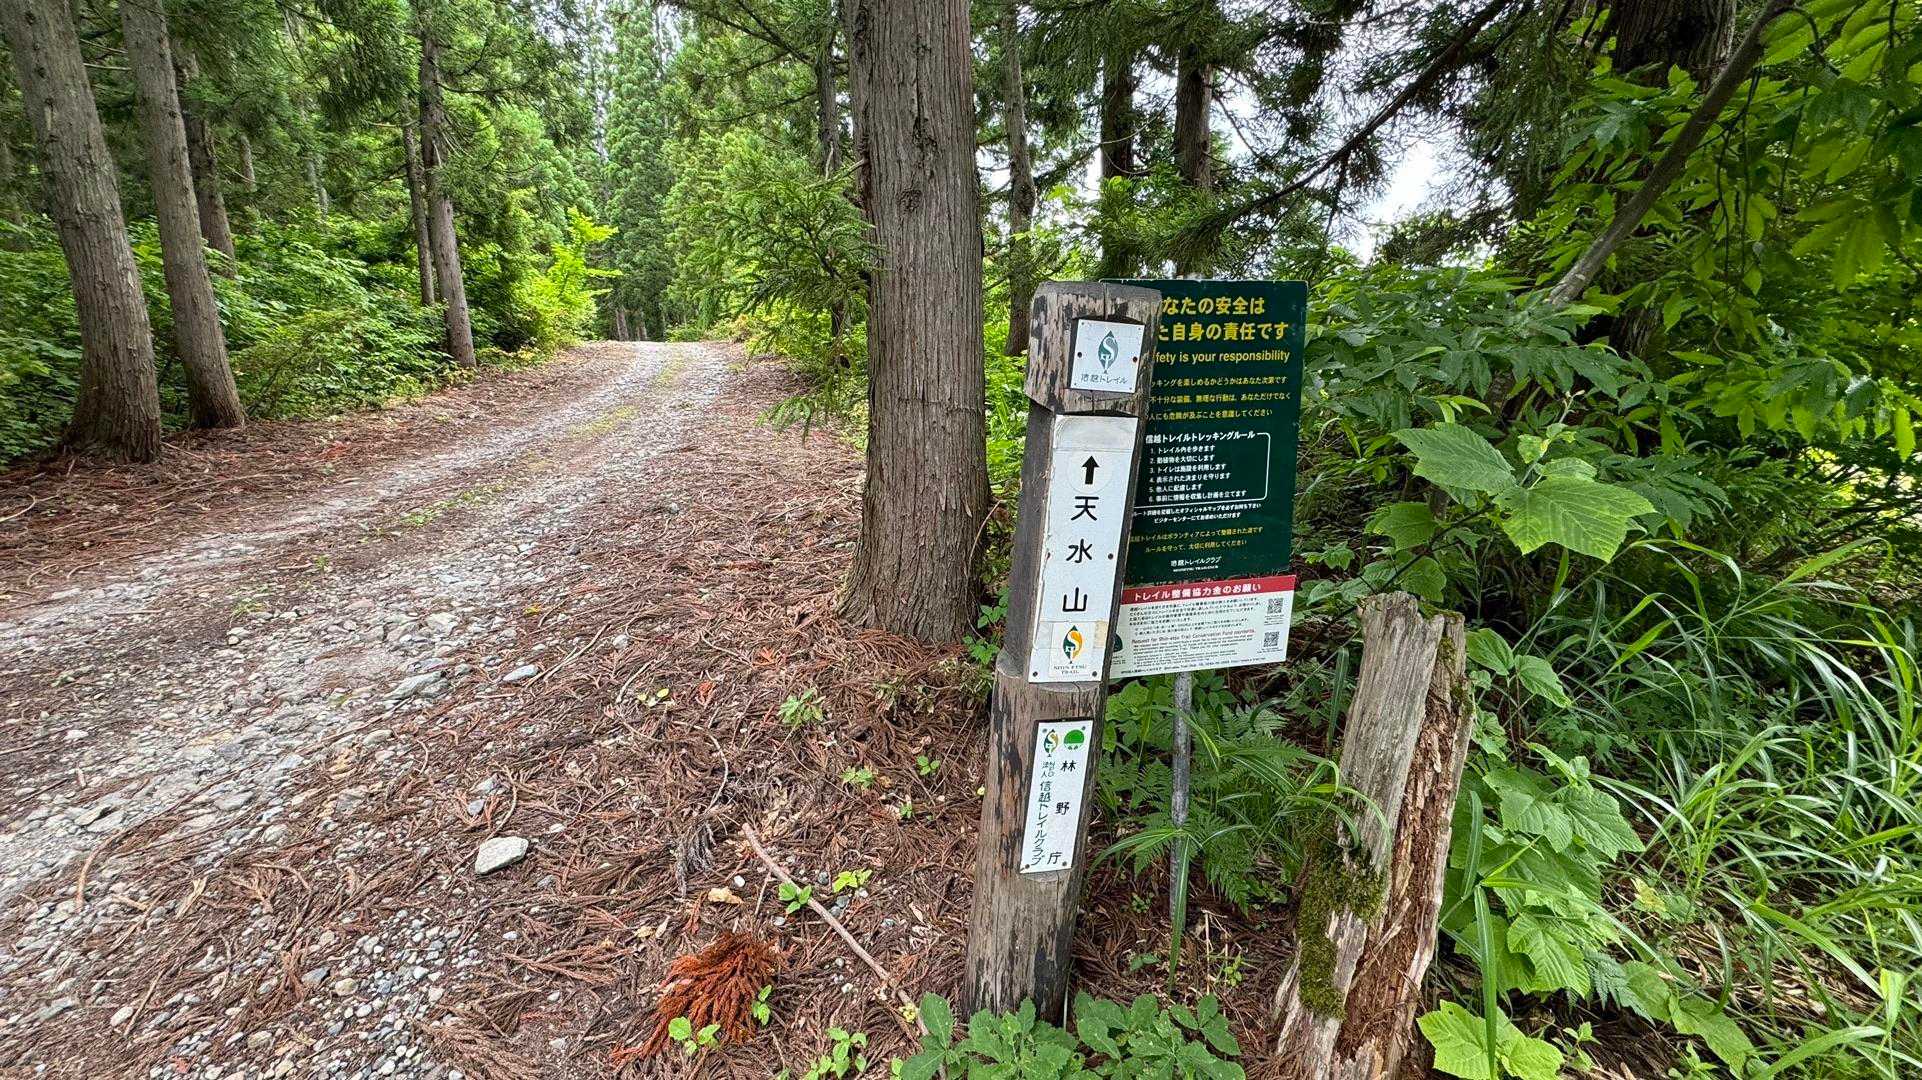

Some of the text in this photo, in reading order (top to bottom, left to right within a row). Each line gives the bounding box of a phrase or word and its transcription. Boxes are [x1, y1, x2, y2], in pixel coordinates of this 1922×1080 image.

[1153, 350, 1290, 365] fety is your responsibility
[1062, 496, 1100, 613] 天水山
[1135, 583, 1262, 601] トレイル整備協力金のお願い
[1047, 760, 1076, 865] 林野庁
